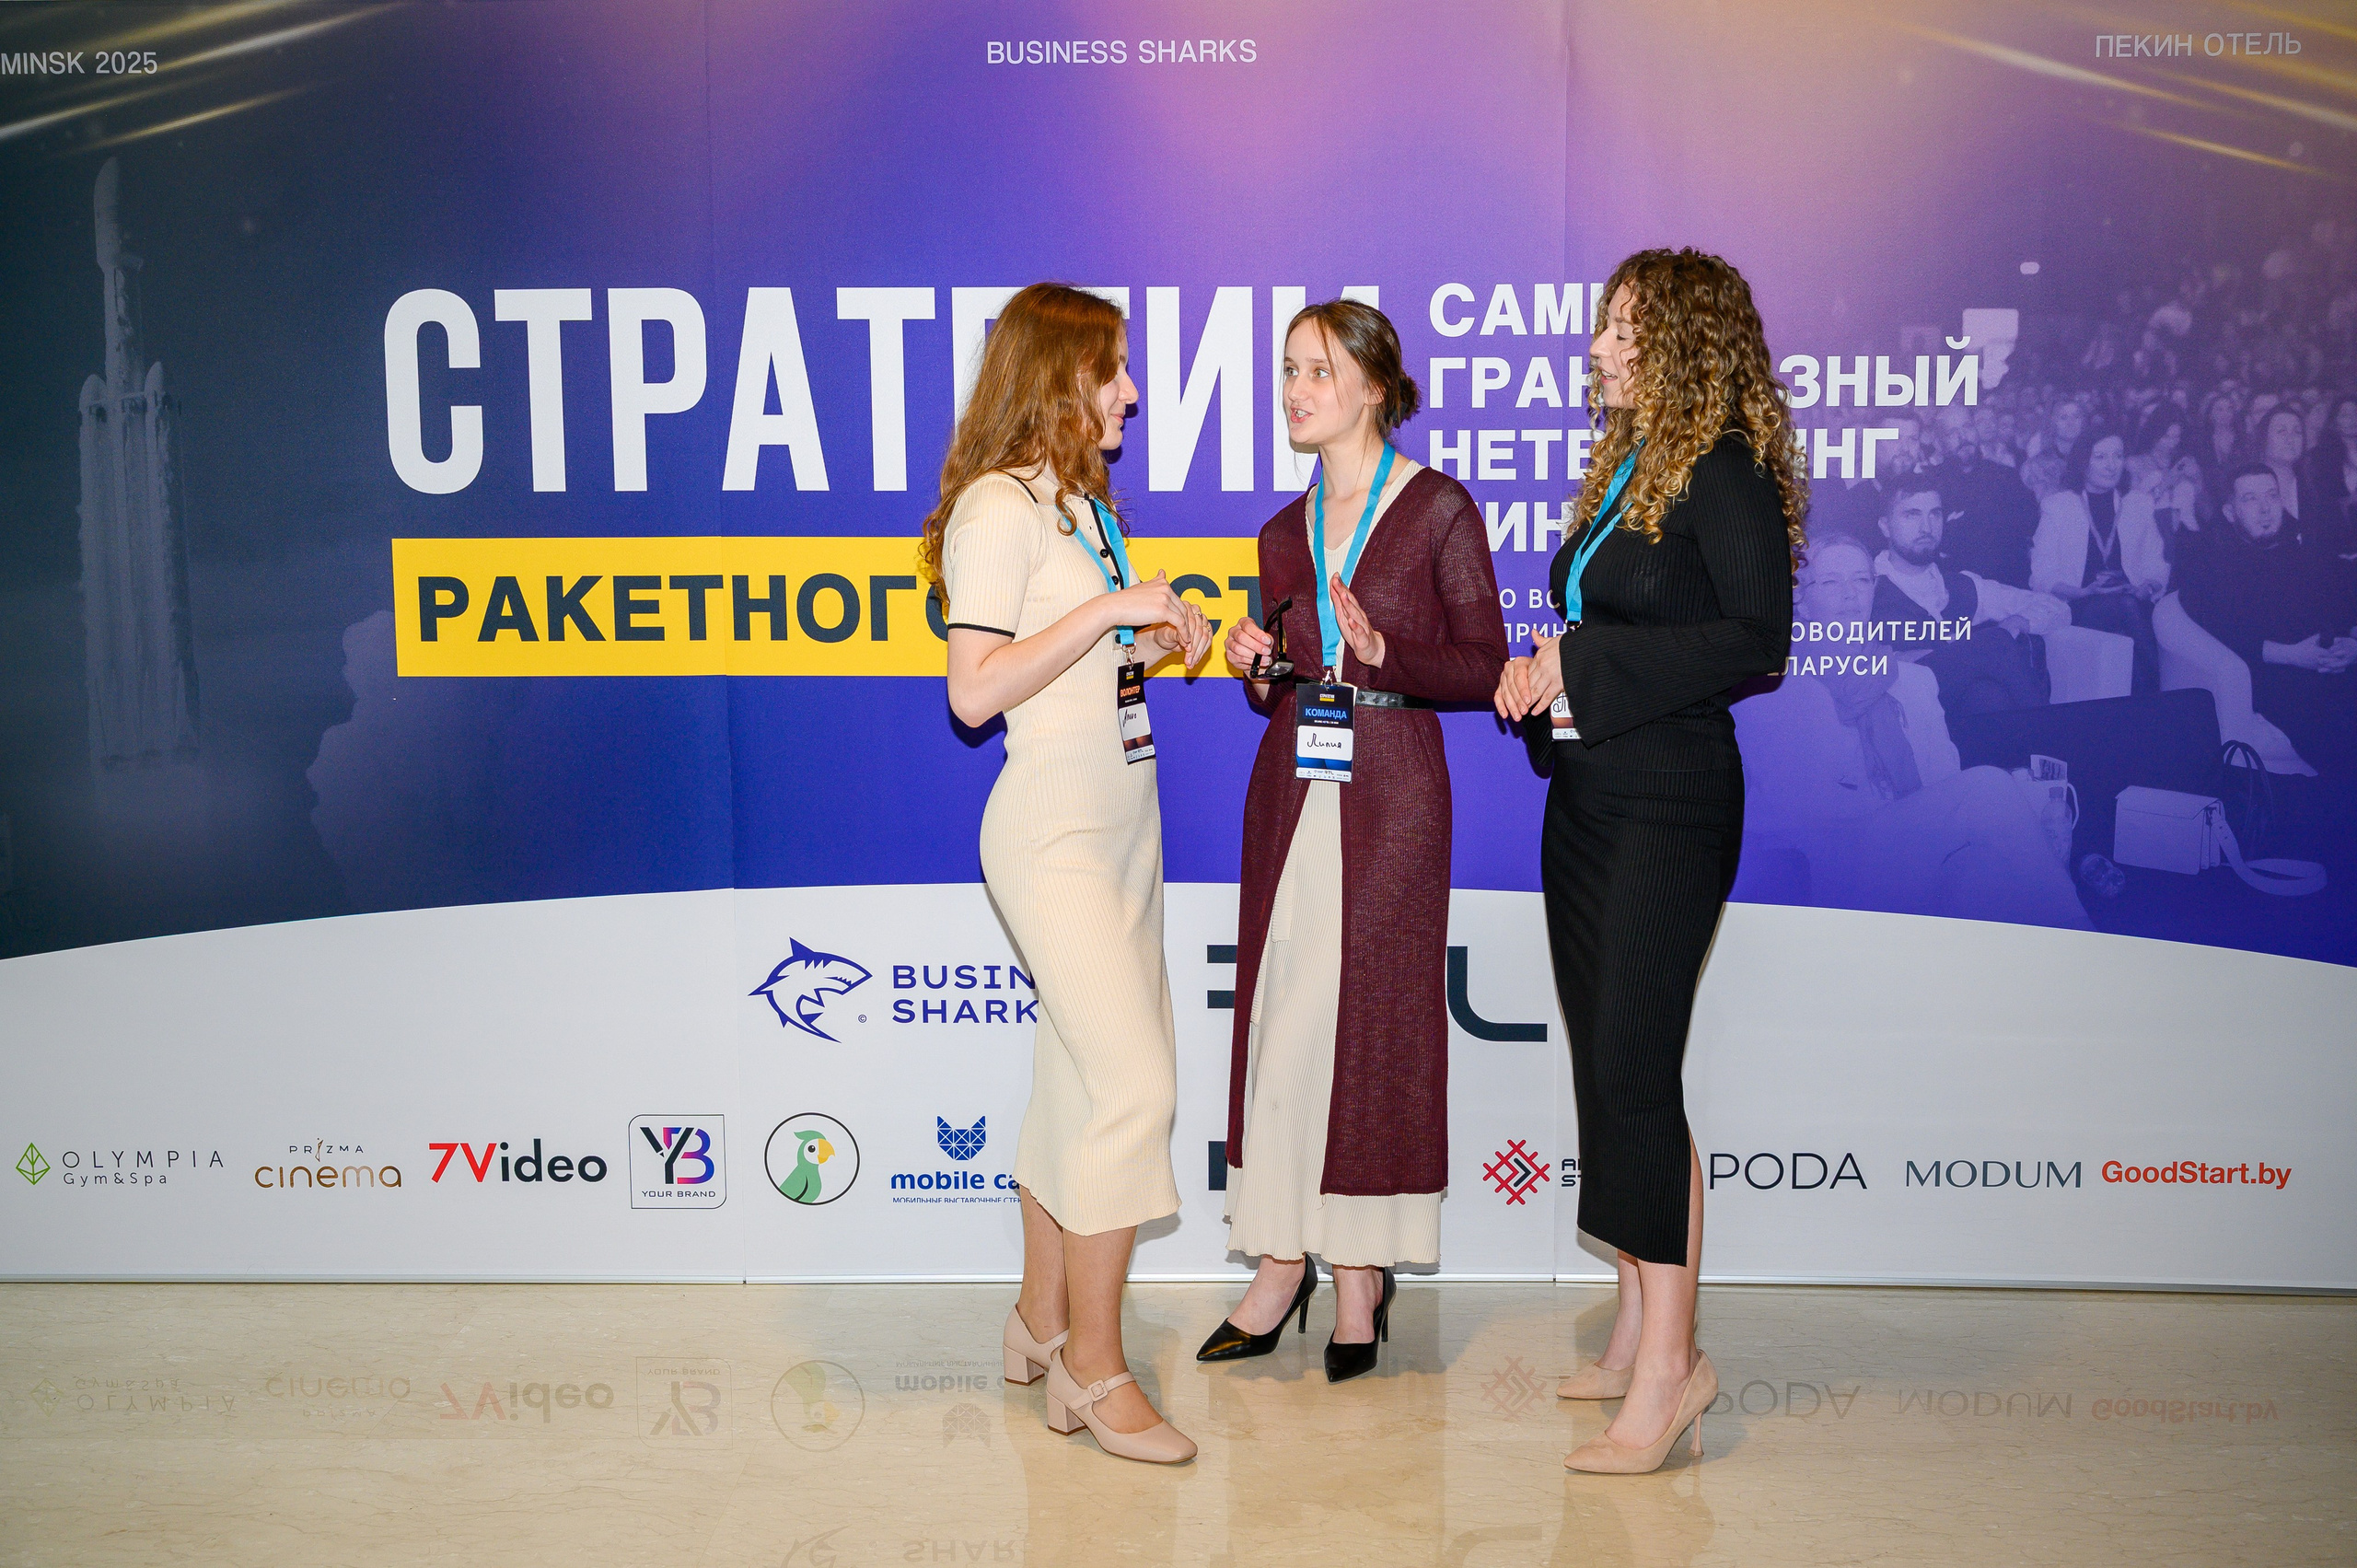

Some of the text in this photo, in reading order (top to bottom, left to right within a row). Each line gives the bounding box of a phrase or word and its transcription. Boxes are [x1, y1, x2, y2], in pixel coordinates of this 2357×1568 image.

[987, 40, 1258, 64] BUSINESS SHARKS
[2096, 32, 2302, 58] ПЕКИН ОТЕЛЬ
[1, 51, 158, 75] MINSK 2025
[1429, 282, 1605, 338] САМ
[1790, 616, 1972, 645] ОВОДИТЕЛЕЙ
[1767, 655, 1888, 677] ЛАРУСИ
[1305, 707, 1348, 721] КОМАНДА
[892, 964, 1037, 990] BUSIN
[891, 998, 1039, 1024] SHARK
[62, 1150, 225, 1169] OLYMPIA
[428, 1138, 609, 1184] 7Video
[1709, 1152, 1868, 1191] PODA
[63, 1171, 168, 1188] Gym&Spa
[253, 1164, 403, 1190] cinema
[890, 1170, 1020, 1191] mobile ca
[1905, 1159, 2083, 1190] MODUM
[2100, 1159, 2293, 1191] GoodStart.by
